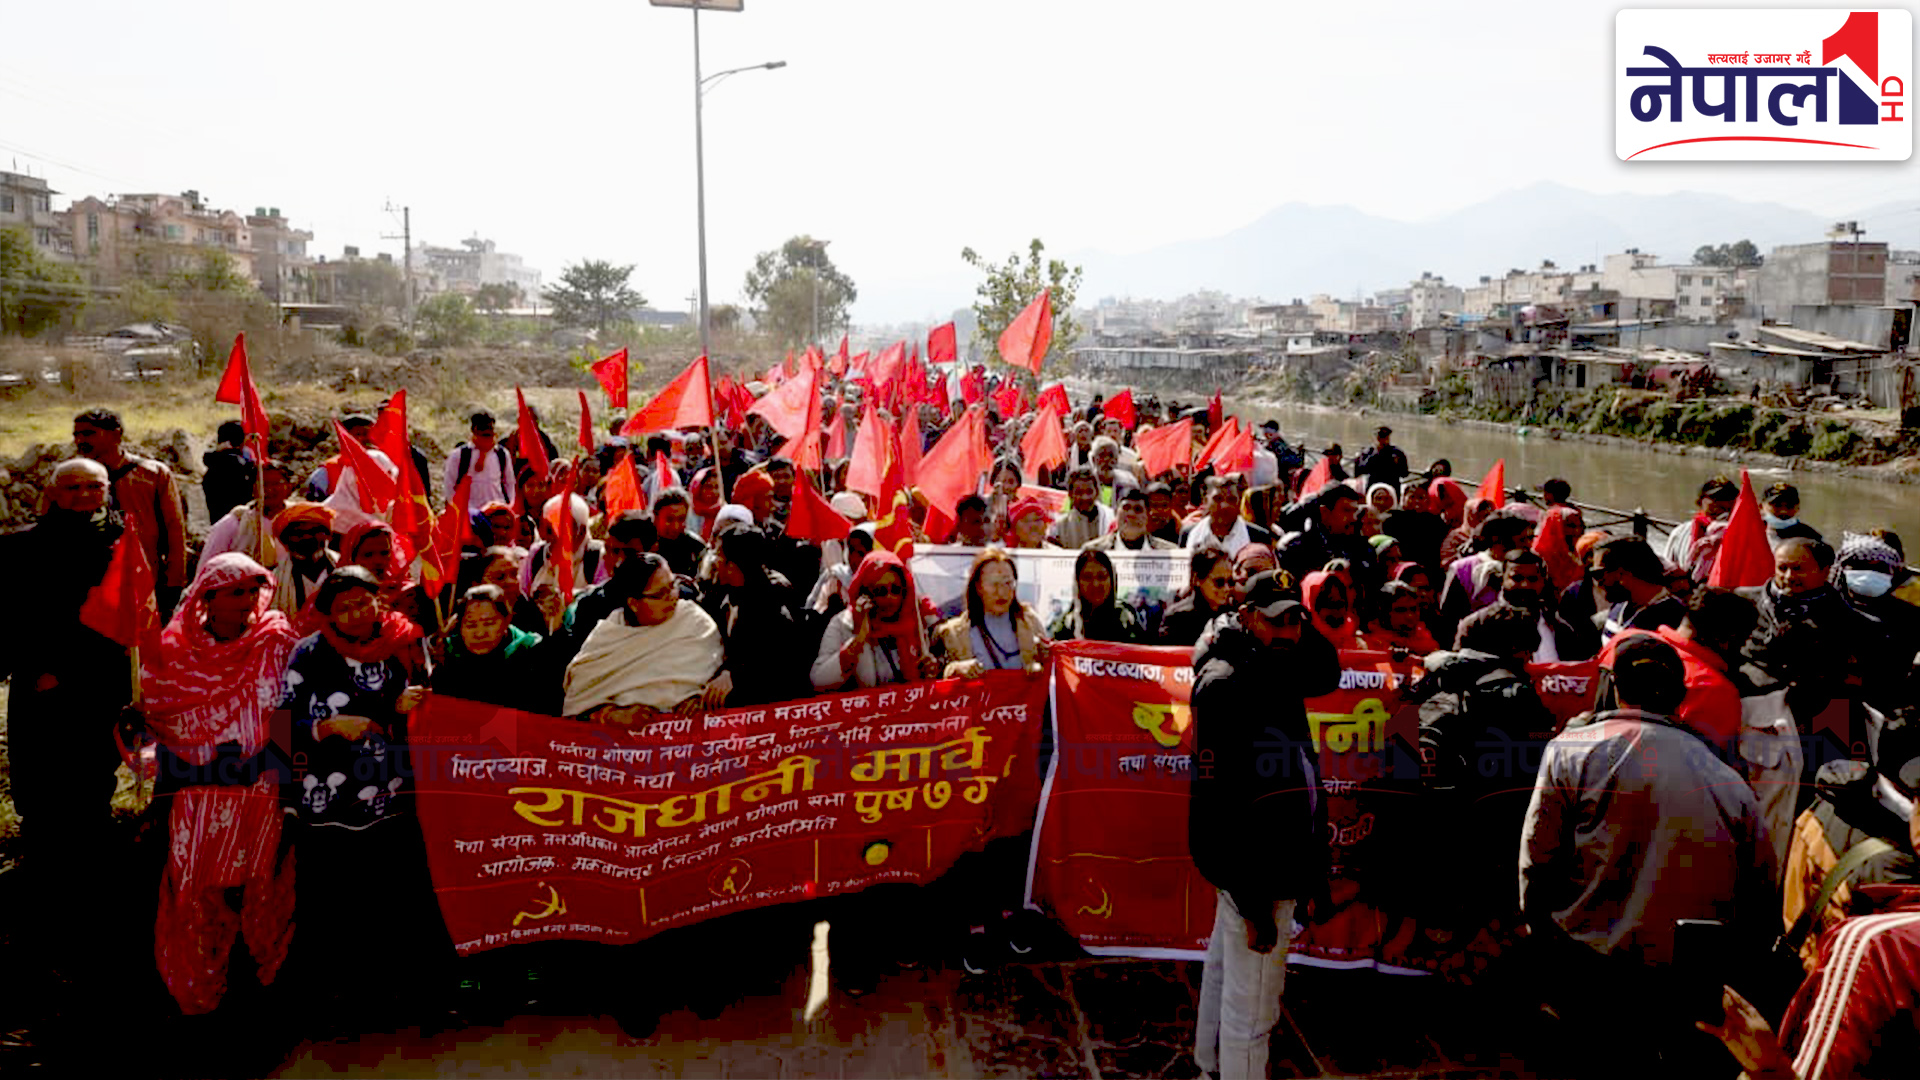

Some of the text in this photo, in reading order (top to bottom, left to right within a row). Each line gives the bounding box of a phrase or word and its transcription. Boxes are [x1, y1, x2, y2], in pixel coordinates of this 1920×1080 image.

[602, 743, 653, 764] शोषण
[660, 744, 694, 761] तथा
[508, 726, 992, 837] राजधानी मार्च
[633, 771, 677, 790] तथा
